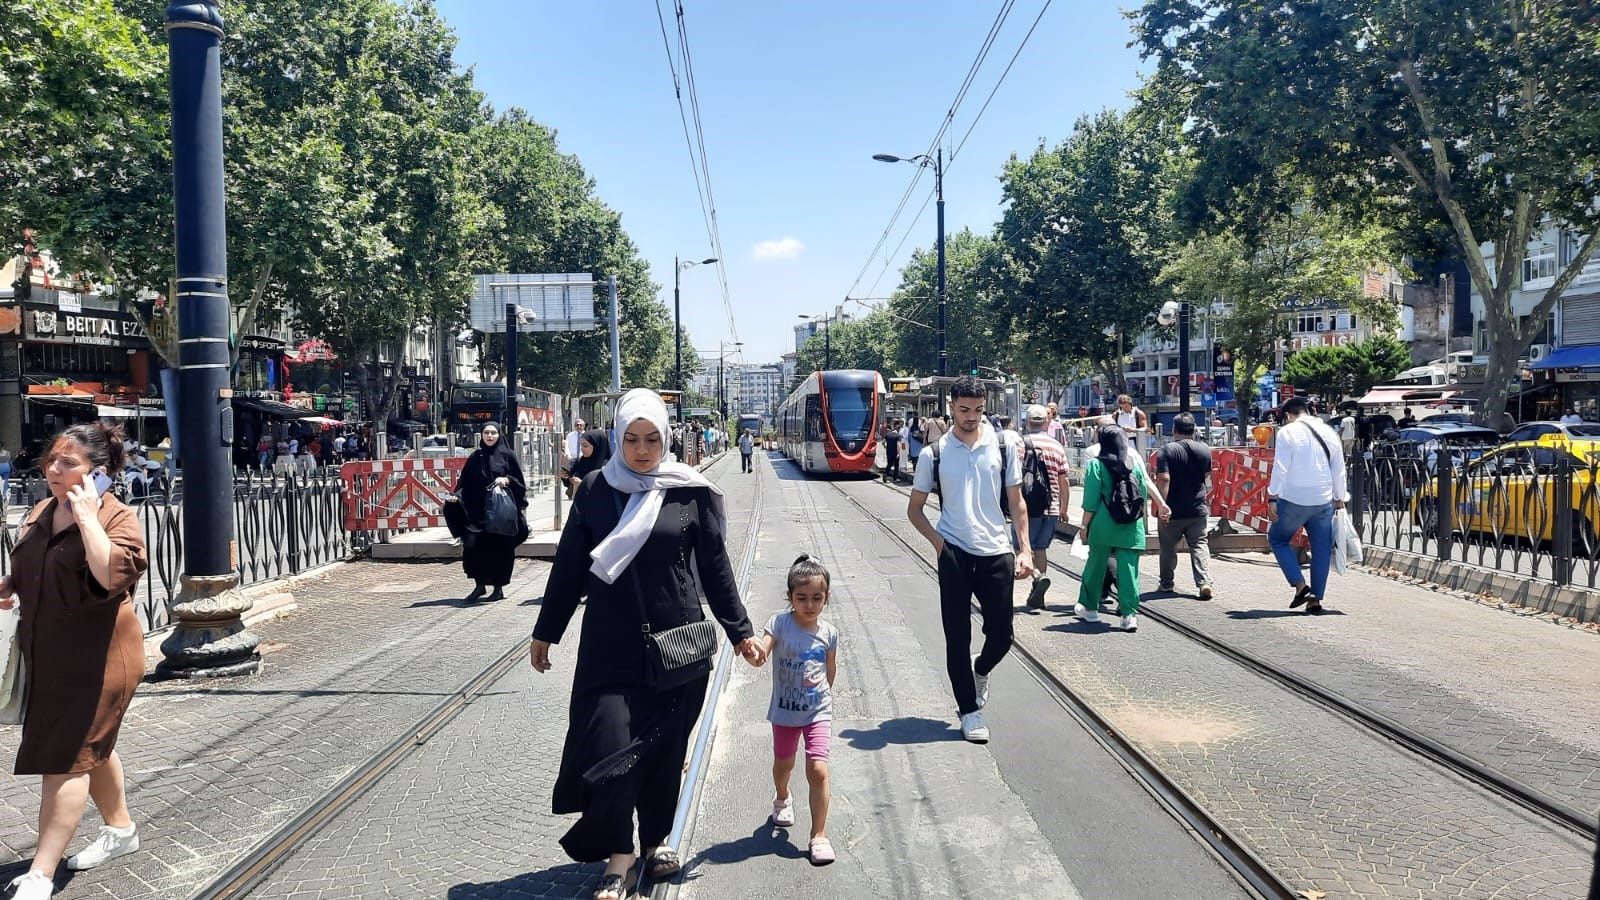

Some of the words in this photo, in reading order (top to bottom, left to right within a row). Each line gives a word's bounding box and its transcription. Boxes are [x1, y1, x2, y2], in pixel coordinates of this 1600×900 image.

[66, 316, 98, 333] BEIT
[100, 319, 119, 336] AL
[778, 698, 808, 711] Like
